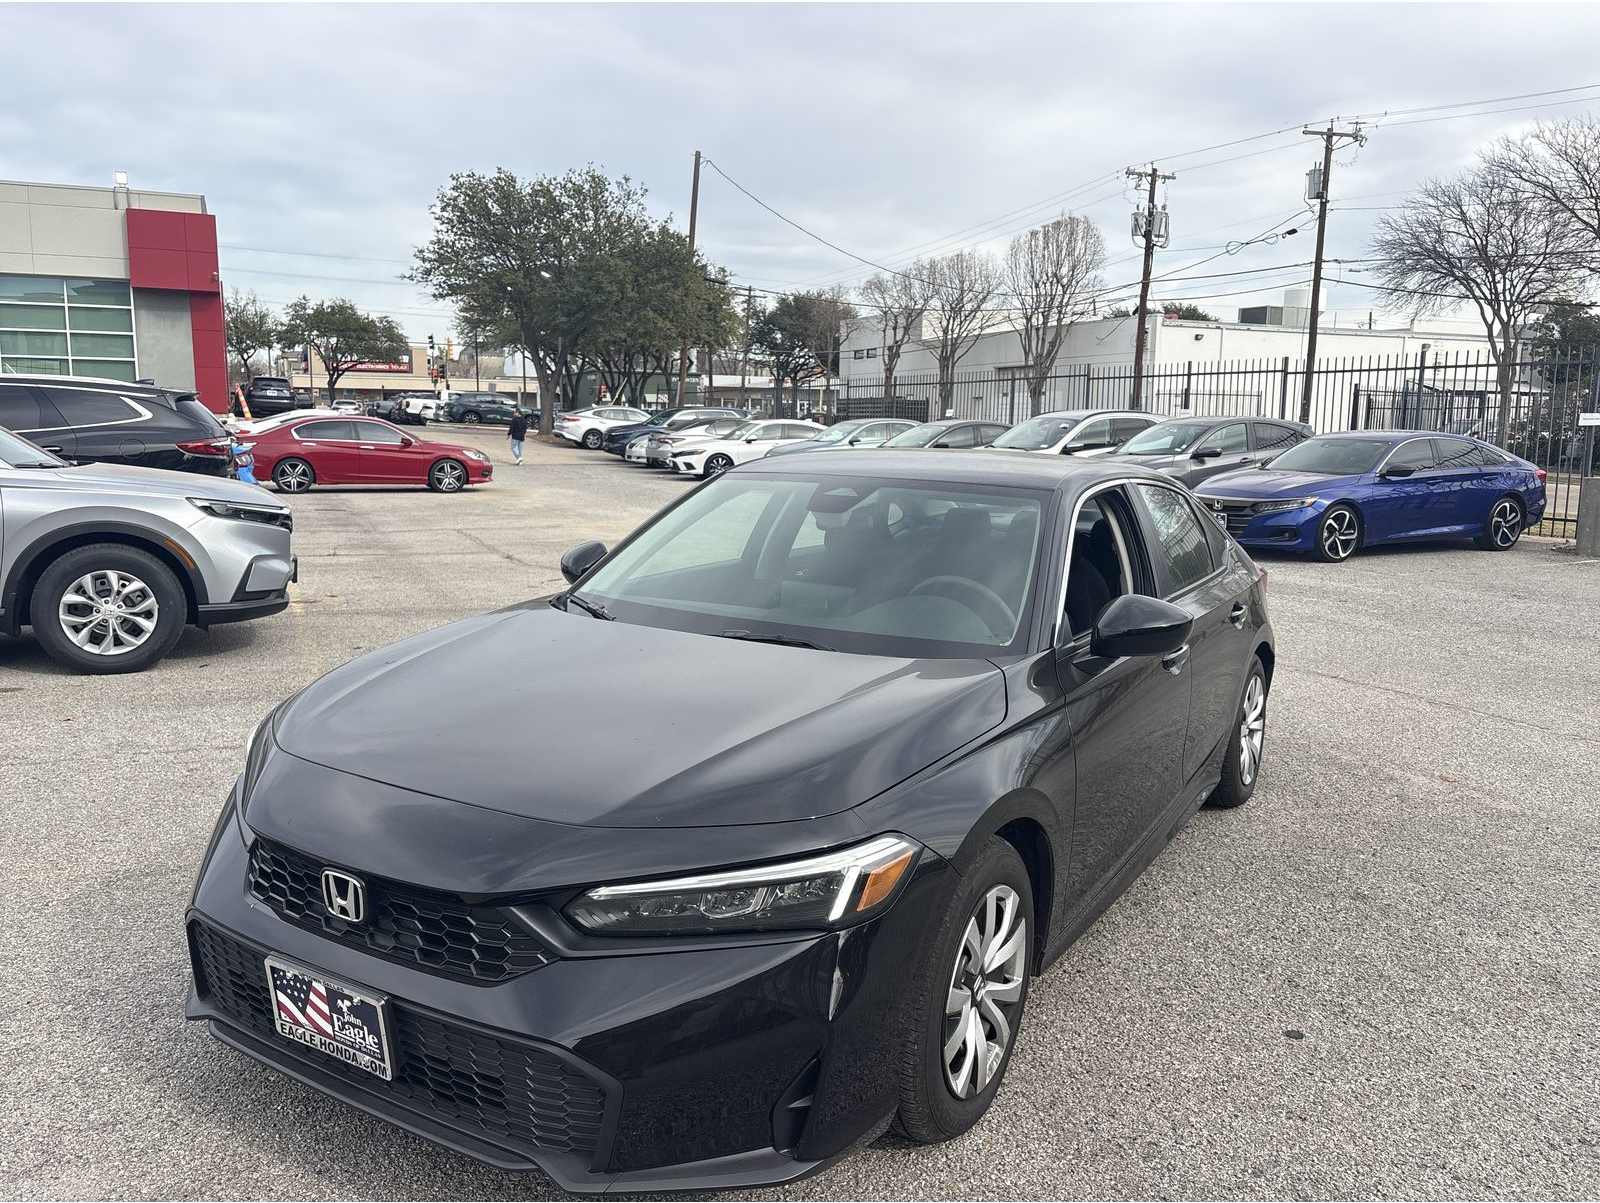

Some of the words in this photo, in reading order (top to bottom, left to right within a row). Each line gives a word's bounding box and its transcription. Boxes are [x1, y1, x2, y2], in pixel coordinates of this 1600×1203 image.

[343, 1010, 362, 1026] John
[281, 1023, 317, 1046] EAGLE
[331, 1012, 379, 1048] Eagle
